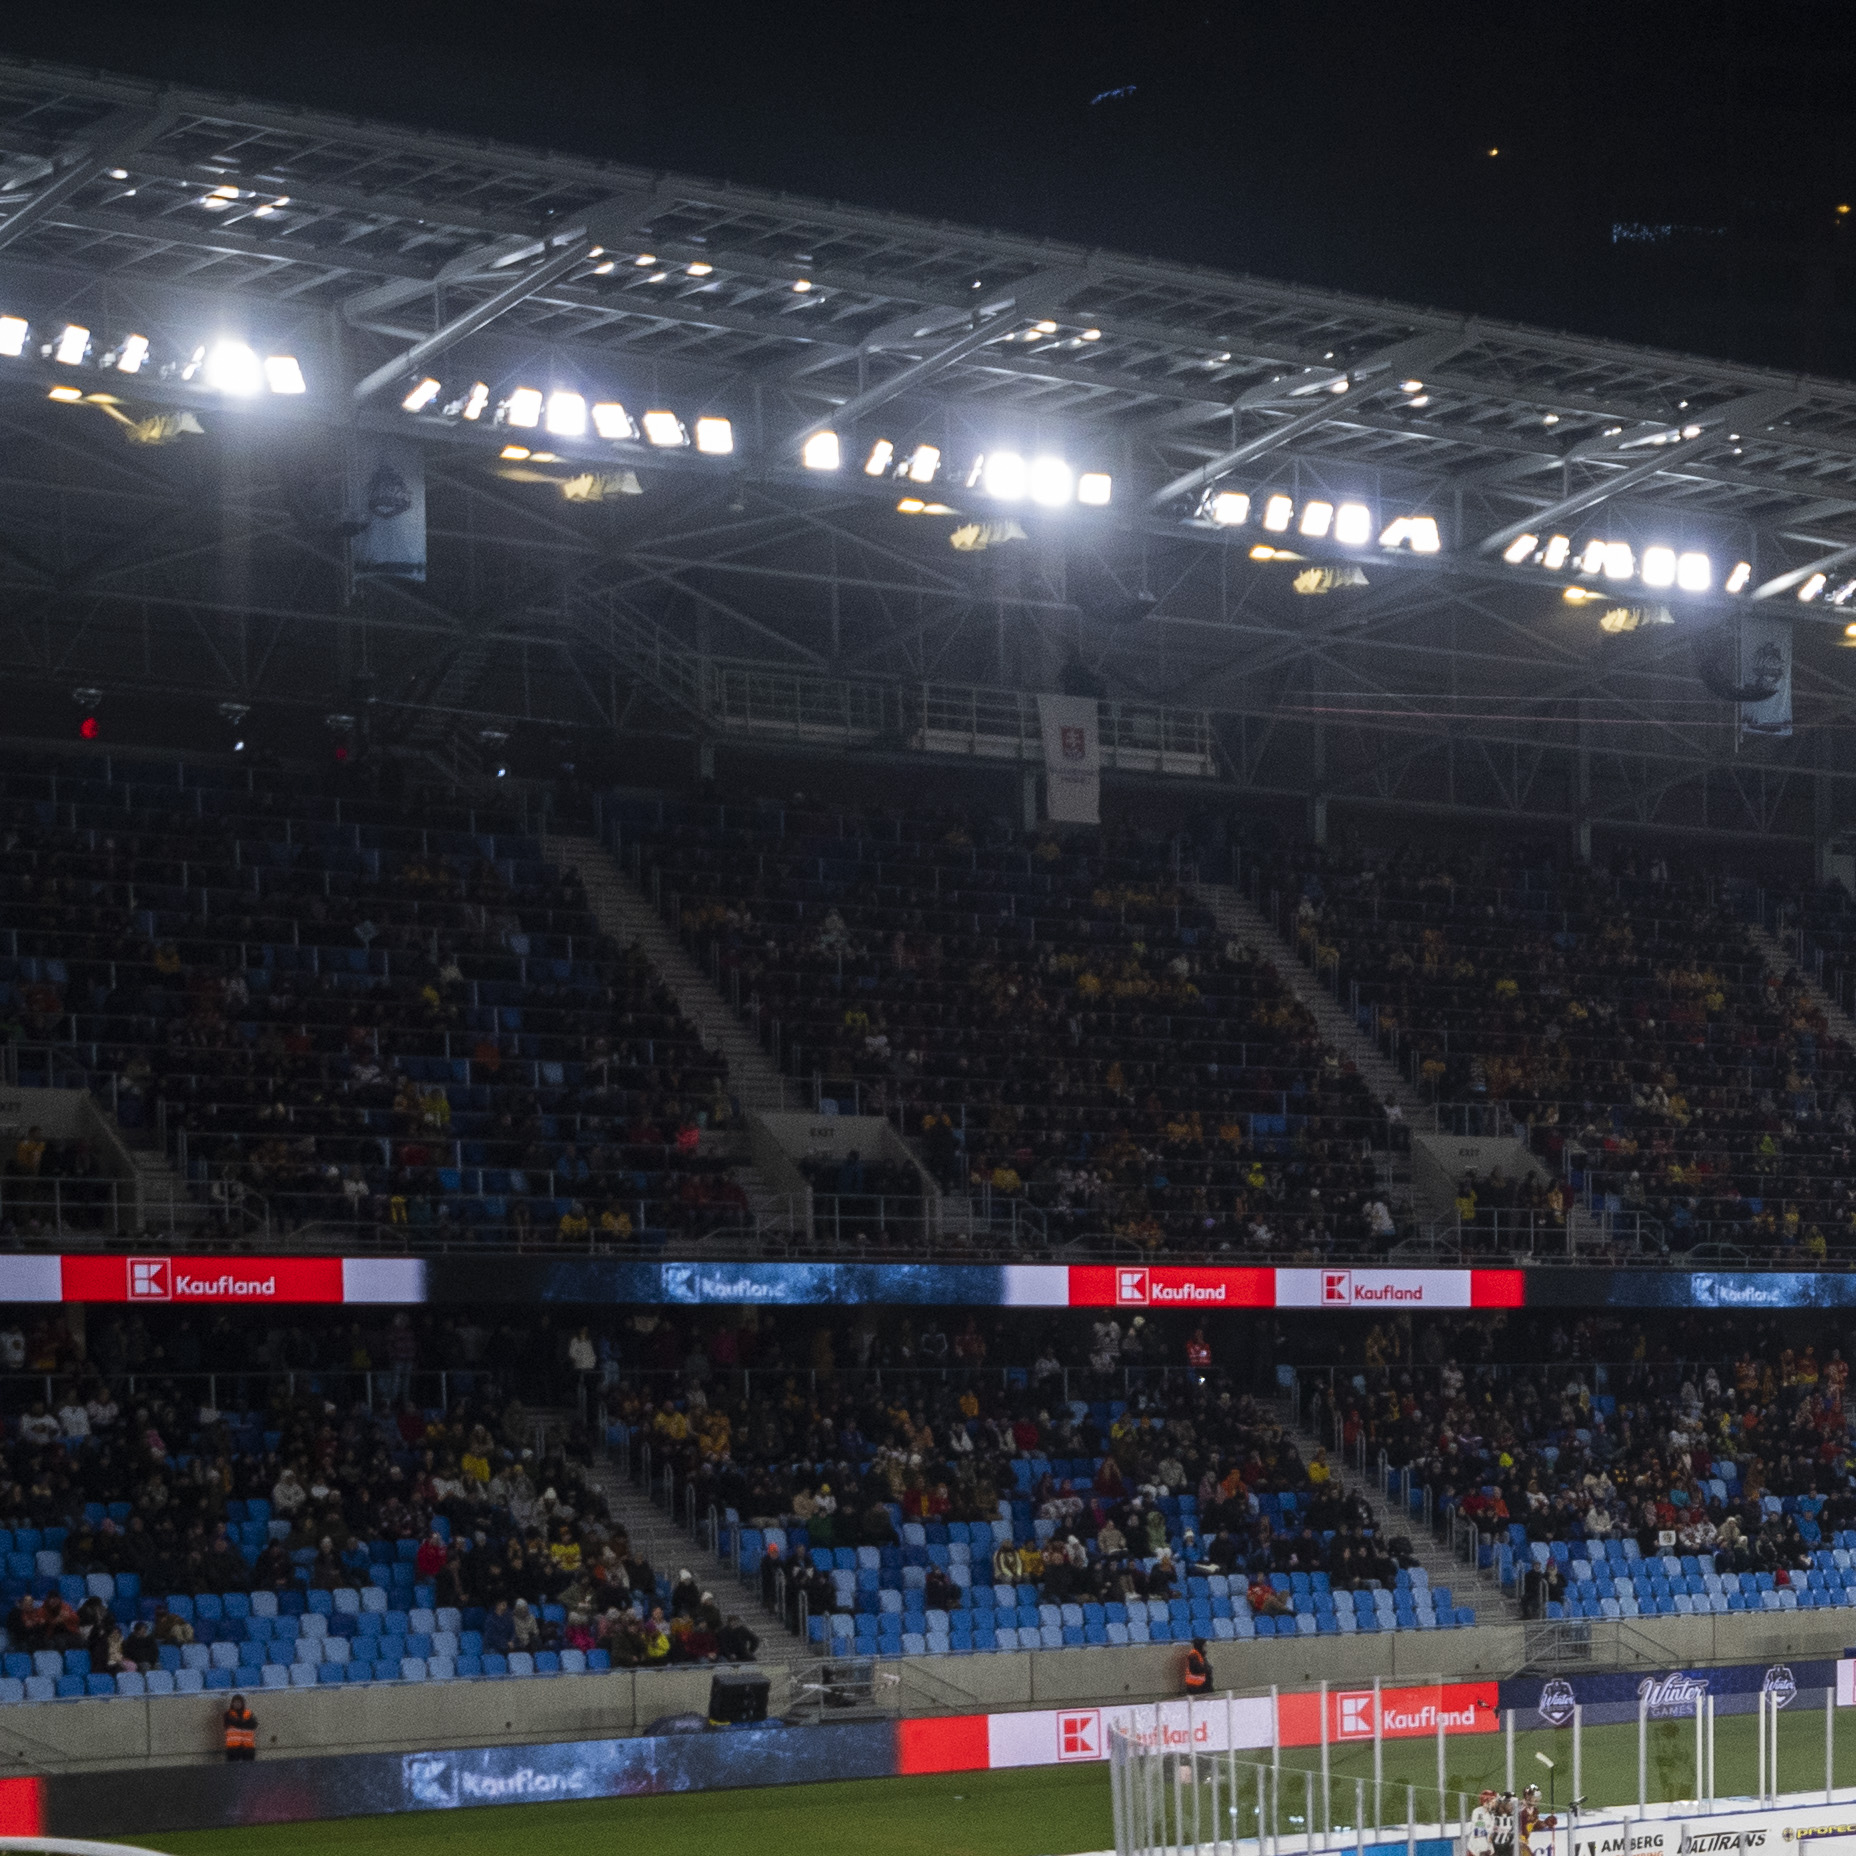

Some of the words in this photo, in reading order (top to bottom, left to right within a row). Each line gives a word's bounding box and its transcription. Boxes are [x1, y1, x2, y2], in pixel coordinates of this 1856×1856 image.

[176, 1275, 275, 1296] Kaufland
[1152, 1284, 1226, 1300] Kaufland
[1354, 1284, 1423, 1301] Kaufland
[1638, 1673, 1708, 1707] Winter
[1384, 1704, 1475, 1730] Kaufland
[1652, 1705, 1694, 1718] GAMES
[1601, 1834, 1664, 1853] AMBERG
